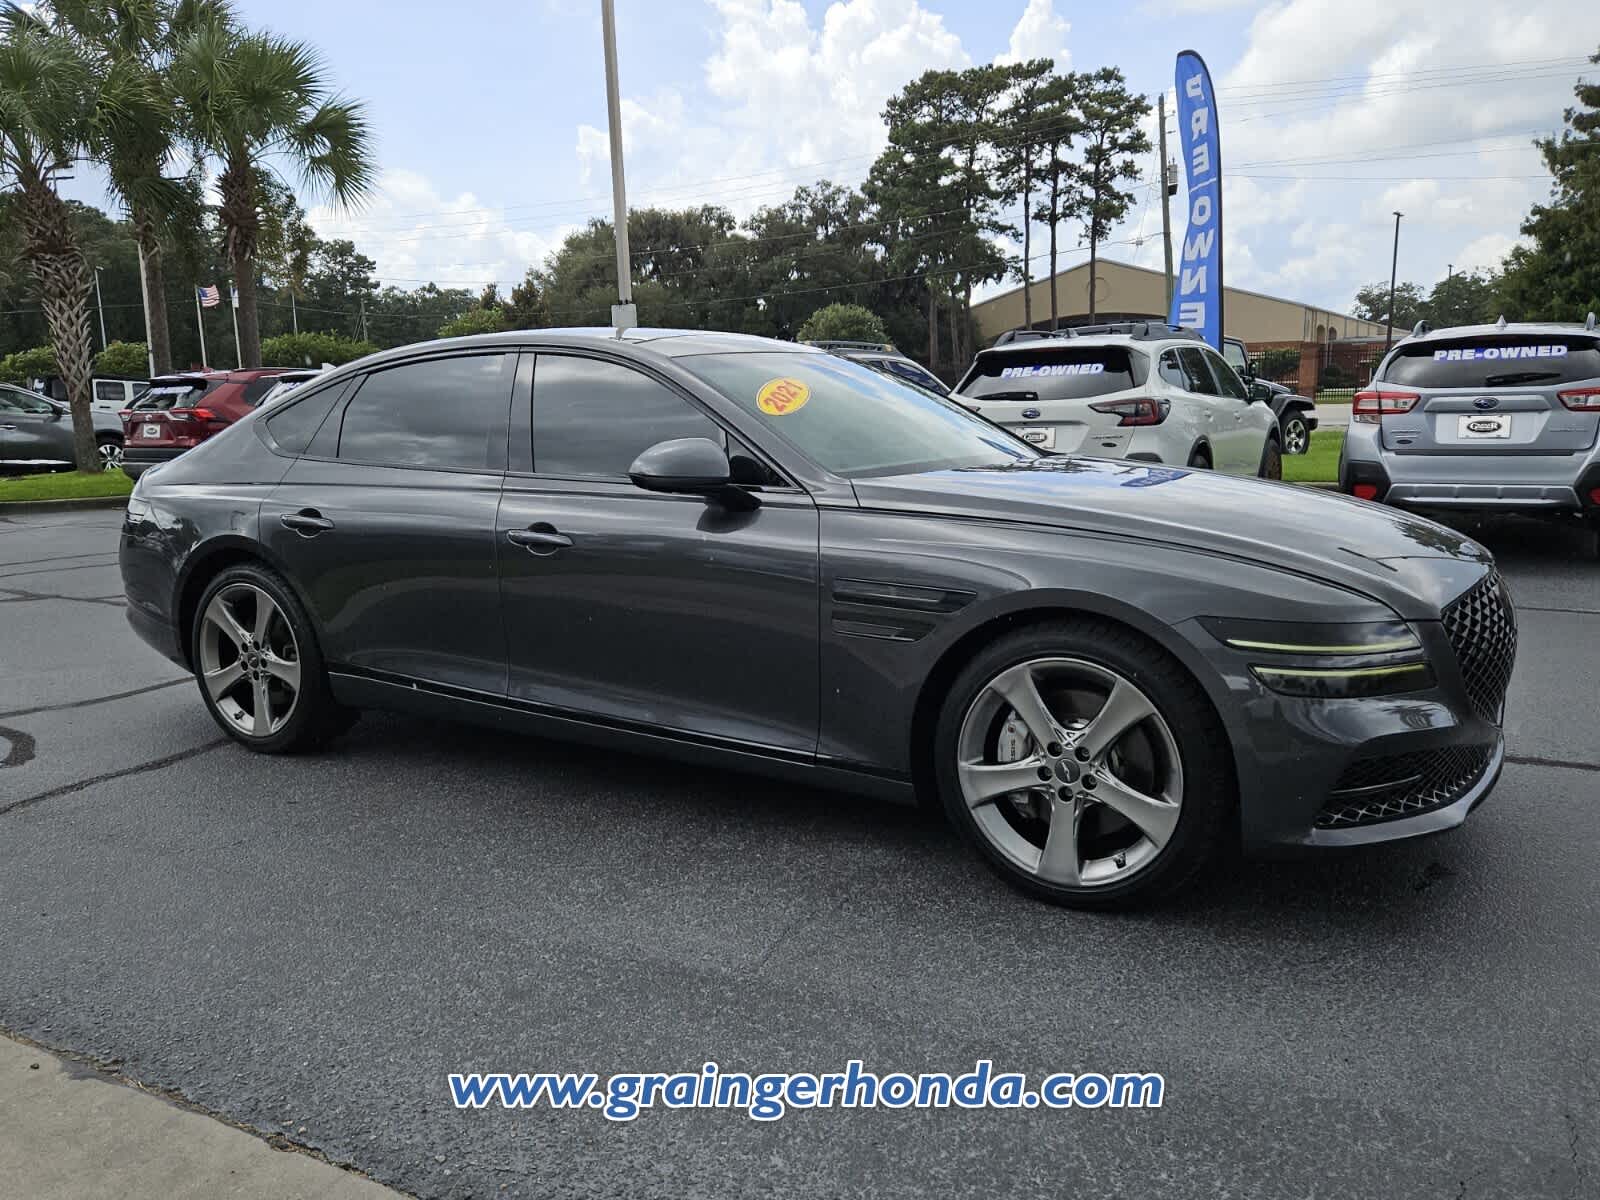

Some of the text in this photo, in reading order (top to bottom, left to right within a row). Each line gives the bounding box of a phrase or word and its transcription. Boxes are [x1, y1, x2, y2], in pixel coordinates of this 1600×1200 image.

[1433, 344, 1568, 361] PRE-OWNED
[1000, 363, 1104, 379] PRE-OWNED
[764, 380, 803, 412] 2021
